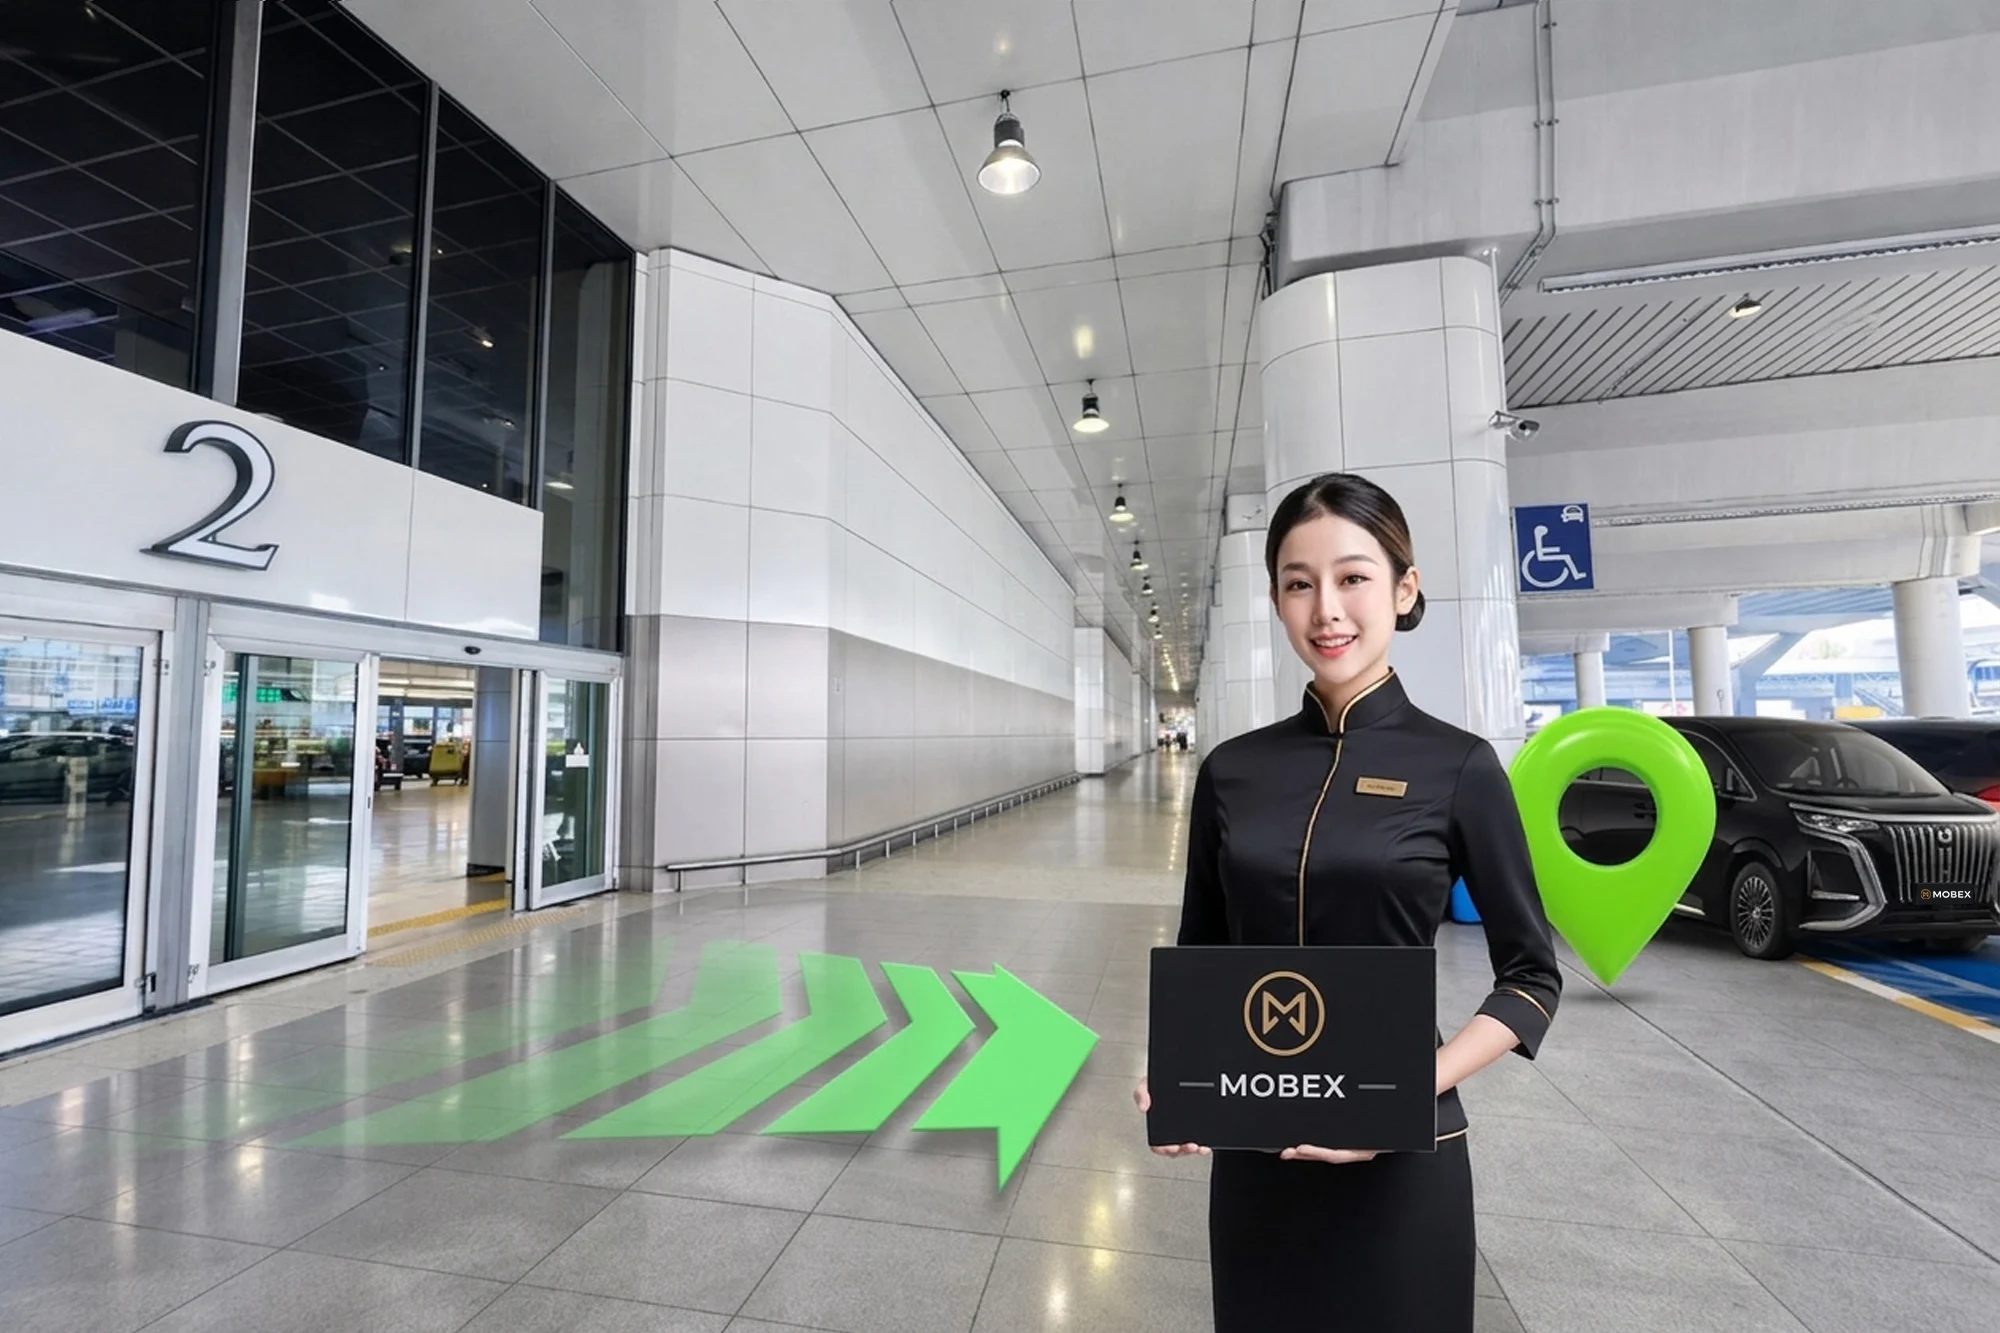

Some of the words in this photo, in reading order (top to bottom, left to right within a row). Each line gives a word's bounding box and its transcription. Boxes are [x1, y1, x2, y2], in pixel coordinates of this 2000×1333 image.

[147, 420, 279, 571] 2
[1932, 890, 1972, 899] MOBEX
[1219, 1073, 1346, 1099] MOBEX
